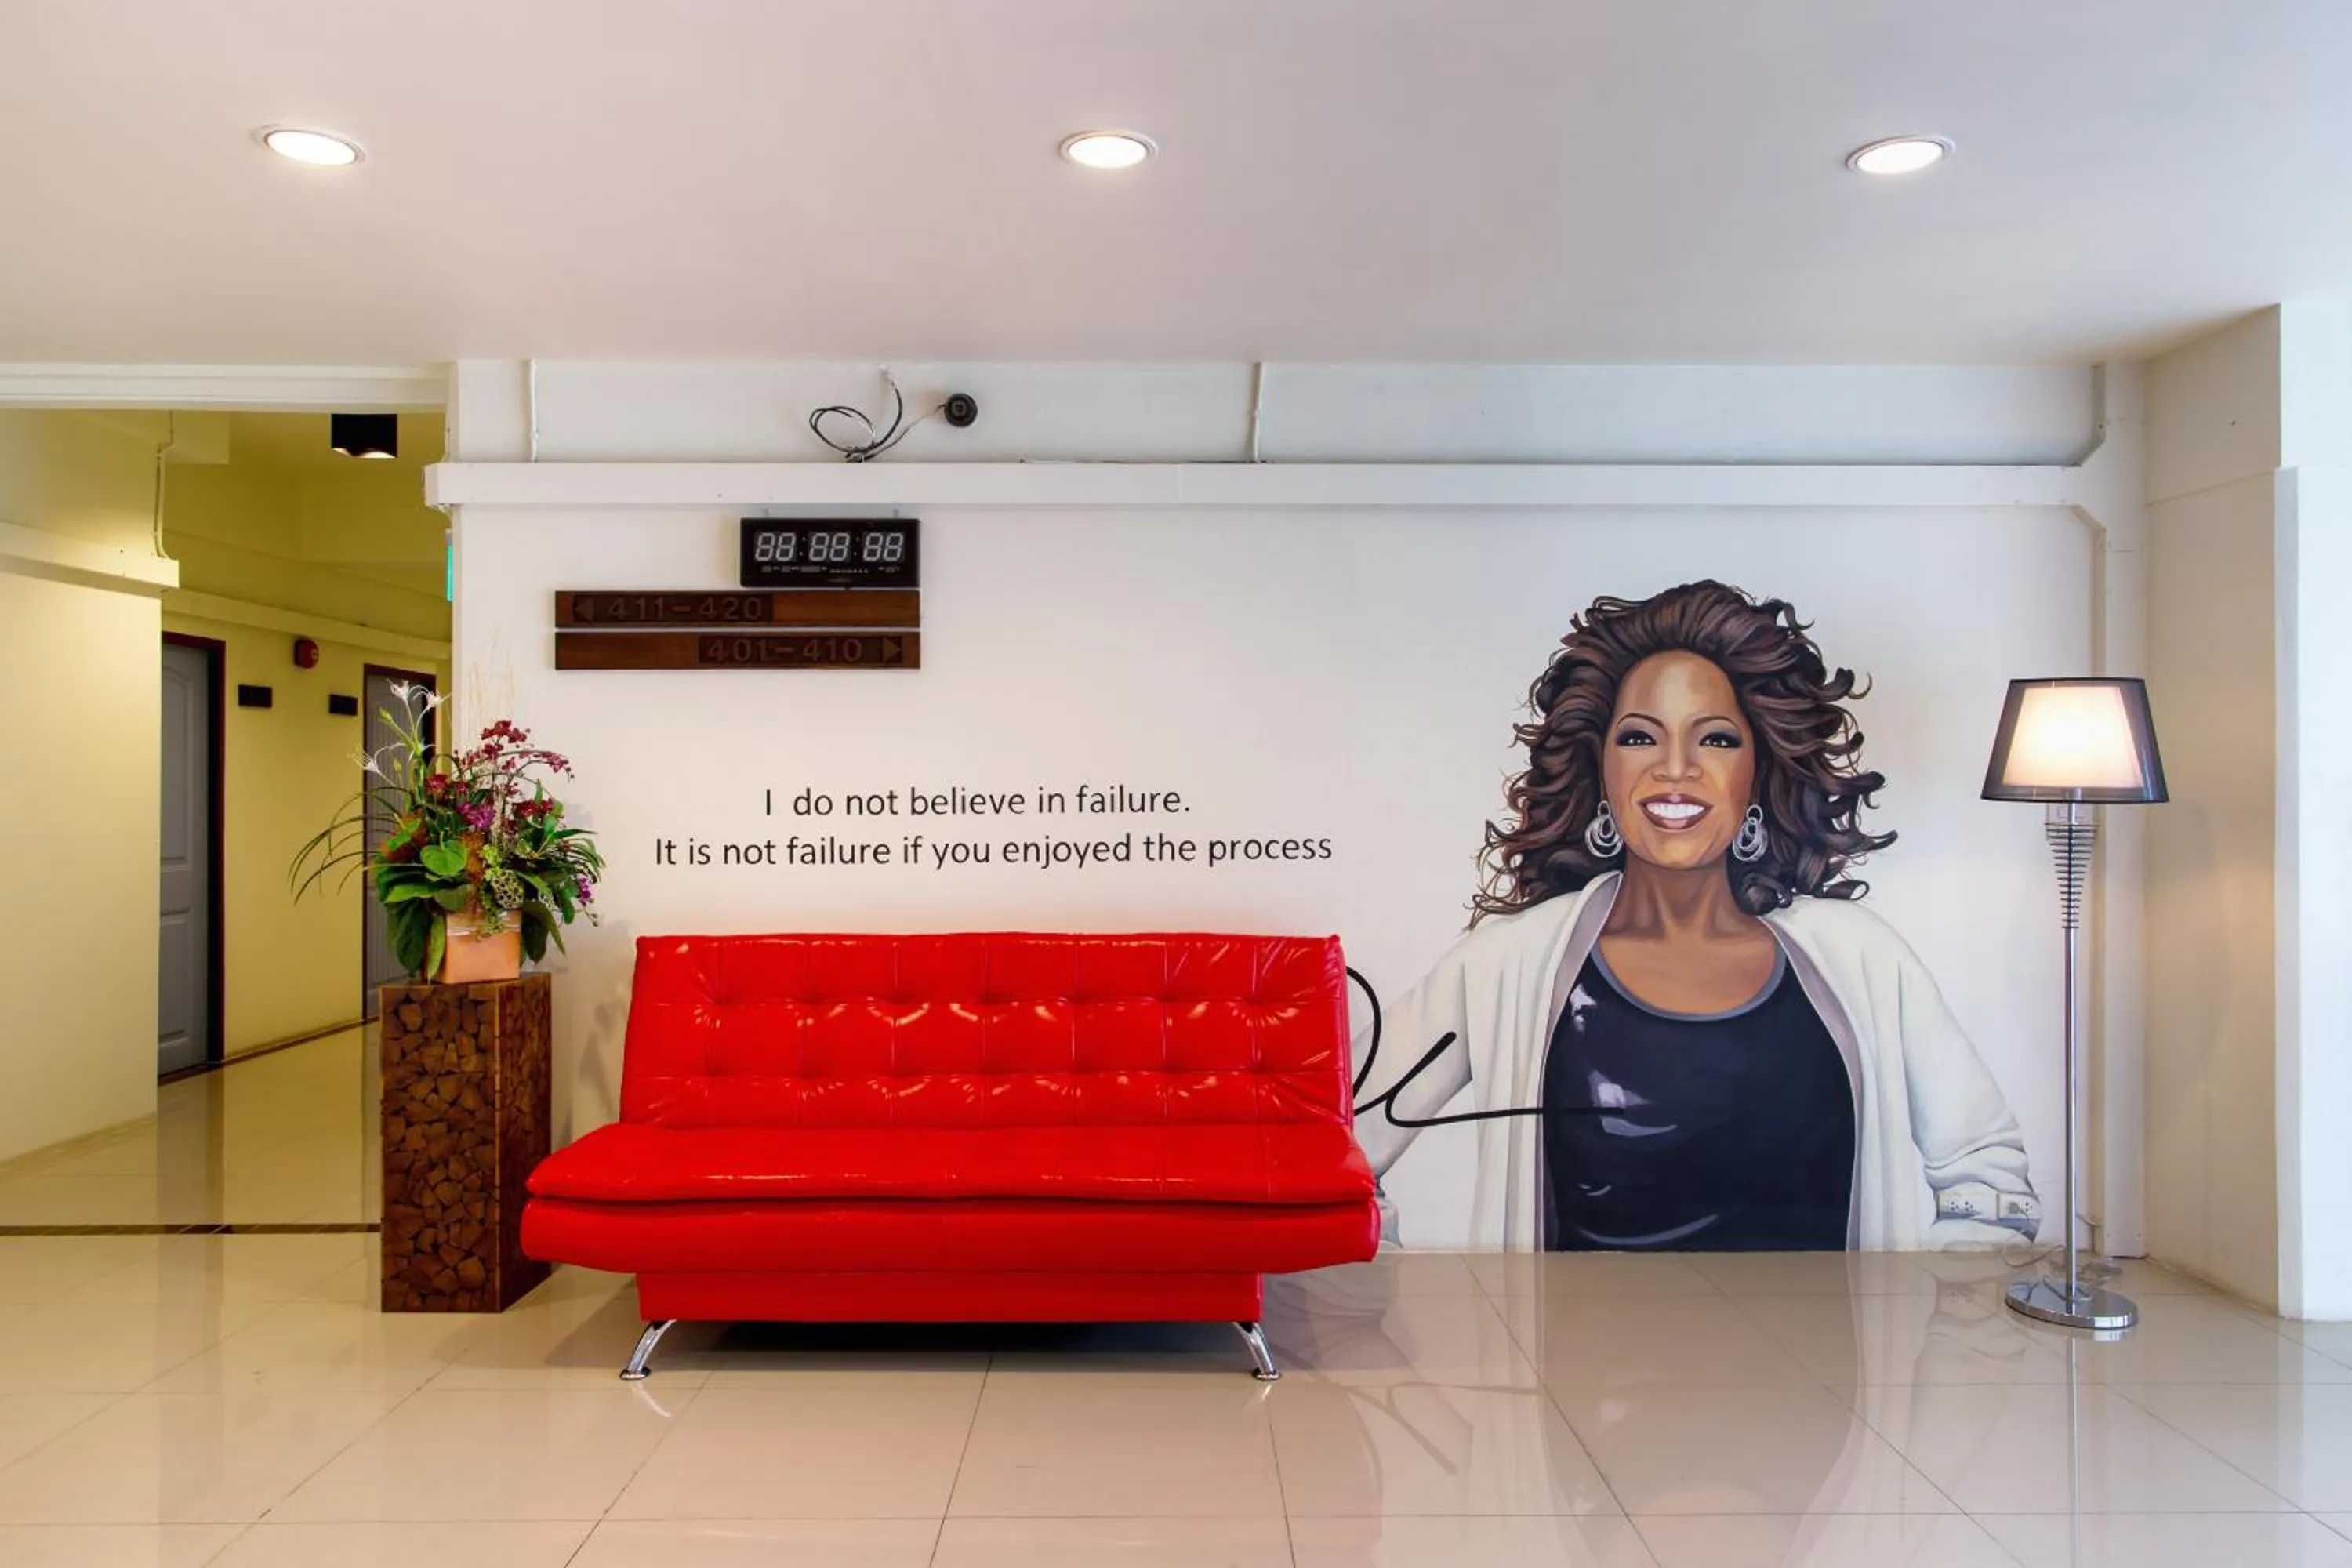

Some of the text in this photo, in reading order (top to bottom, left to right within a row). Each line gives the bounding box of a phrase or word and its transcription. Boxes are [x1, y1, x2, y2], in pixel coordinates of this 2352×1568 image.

[765, 784, 1190, 816] I do not believe in failure.
[655, 833, 1332, 870] It is not failure if you enjoyed the process
